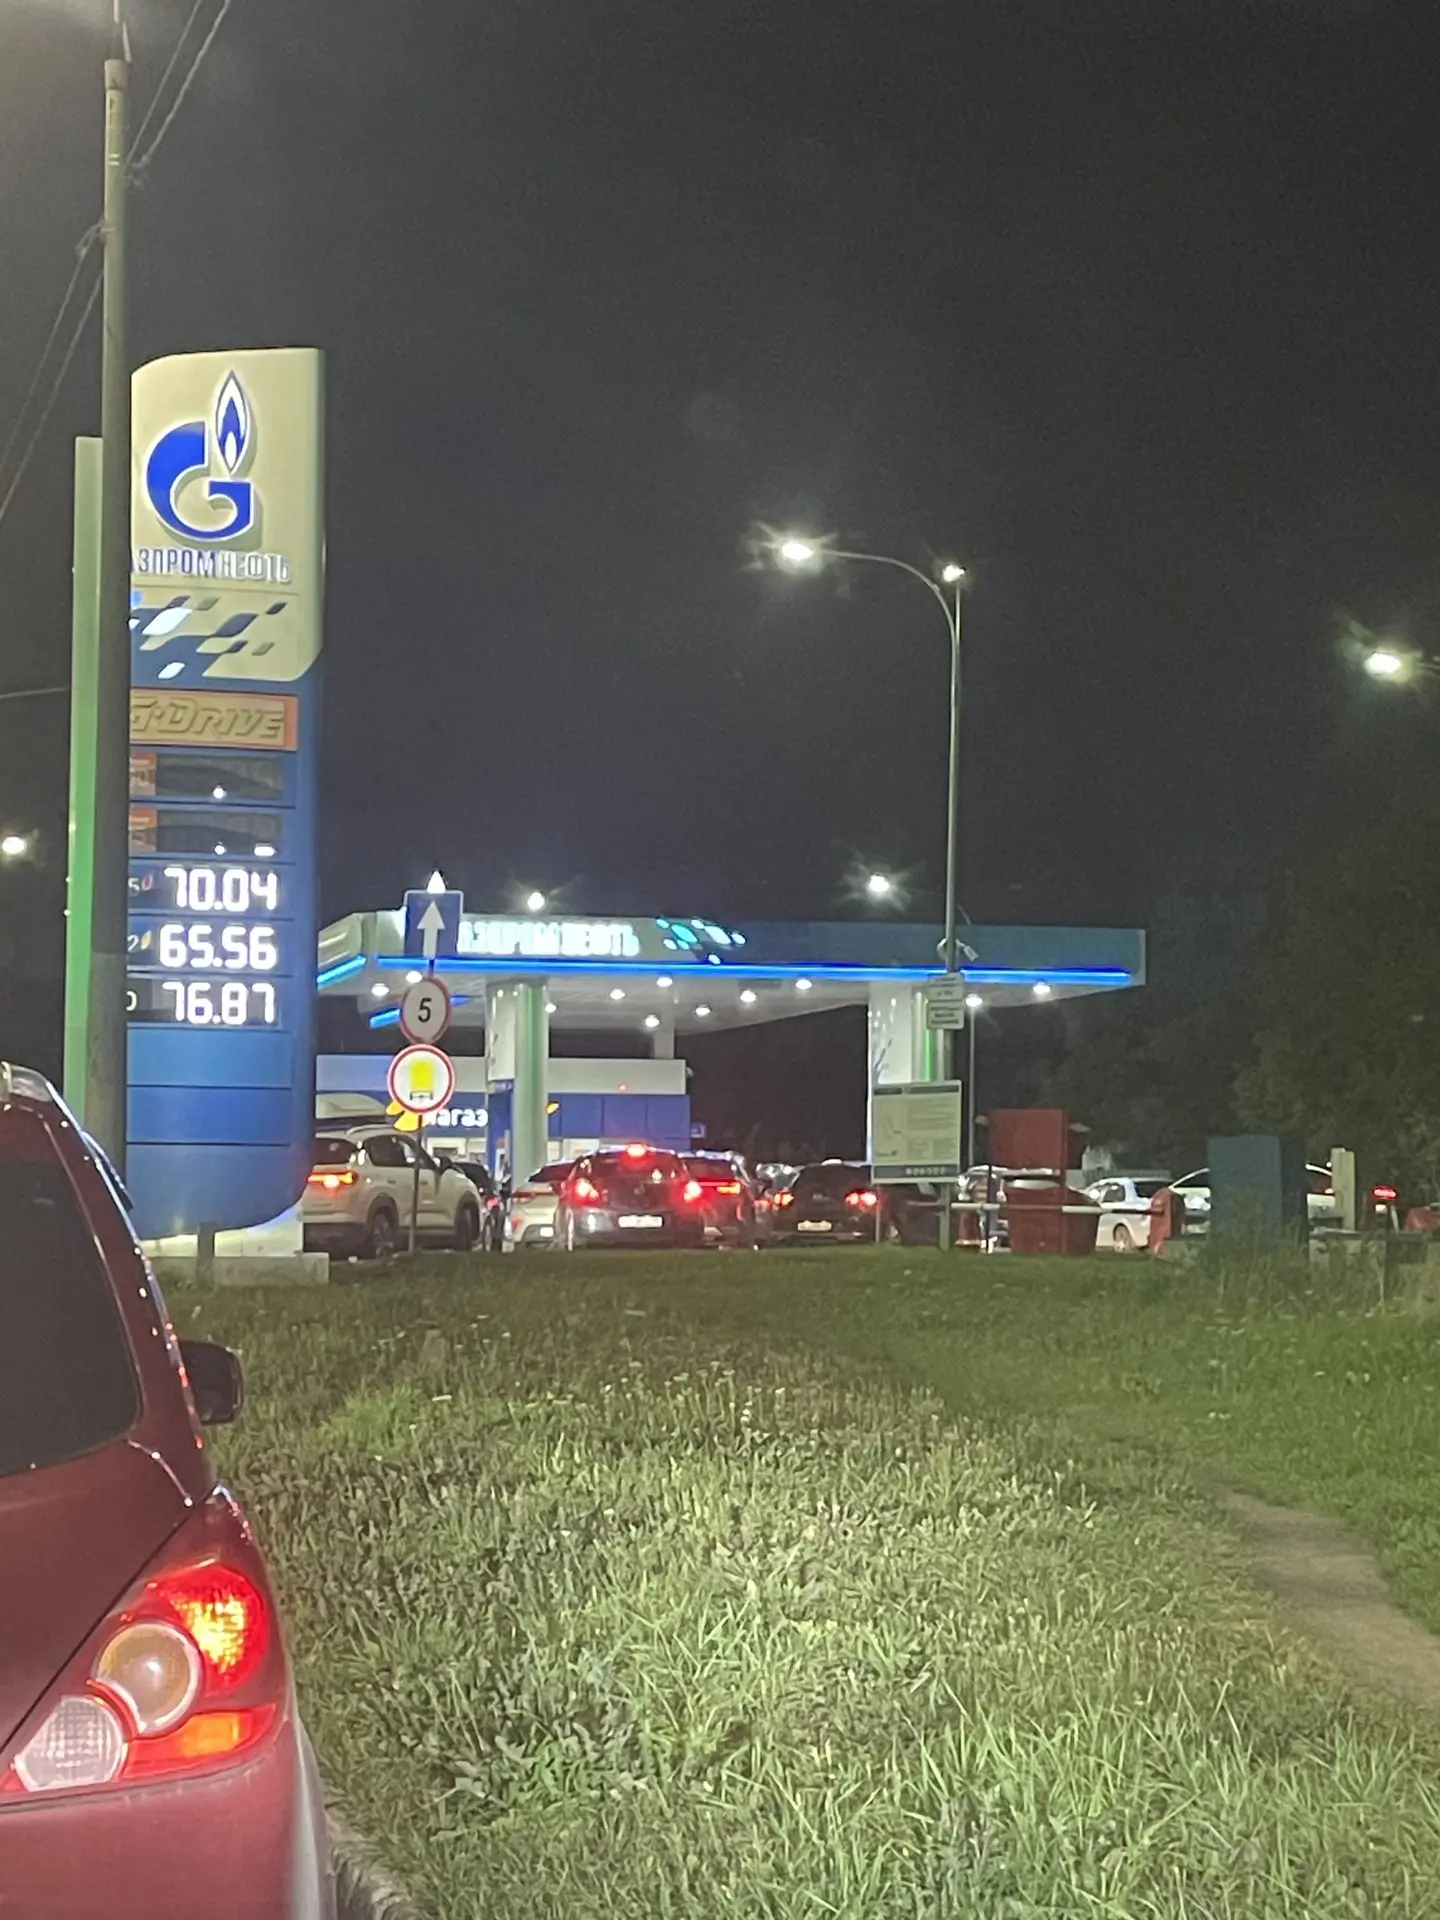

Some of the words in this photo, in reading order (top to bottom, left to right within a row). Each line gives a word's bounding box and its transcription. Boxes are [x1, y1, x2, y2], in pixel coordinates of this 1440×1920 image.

[131, 549, 292, 583] ЗПРОМНЕФТЬ
[164, 867, 277, 912] 70.04
[160, 924, 277, 970] 65.56
[162, 981, 275, 1025] 76.87
[418, 997, 432, 1023] 5
